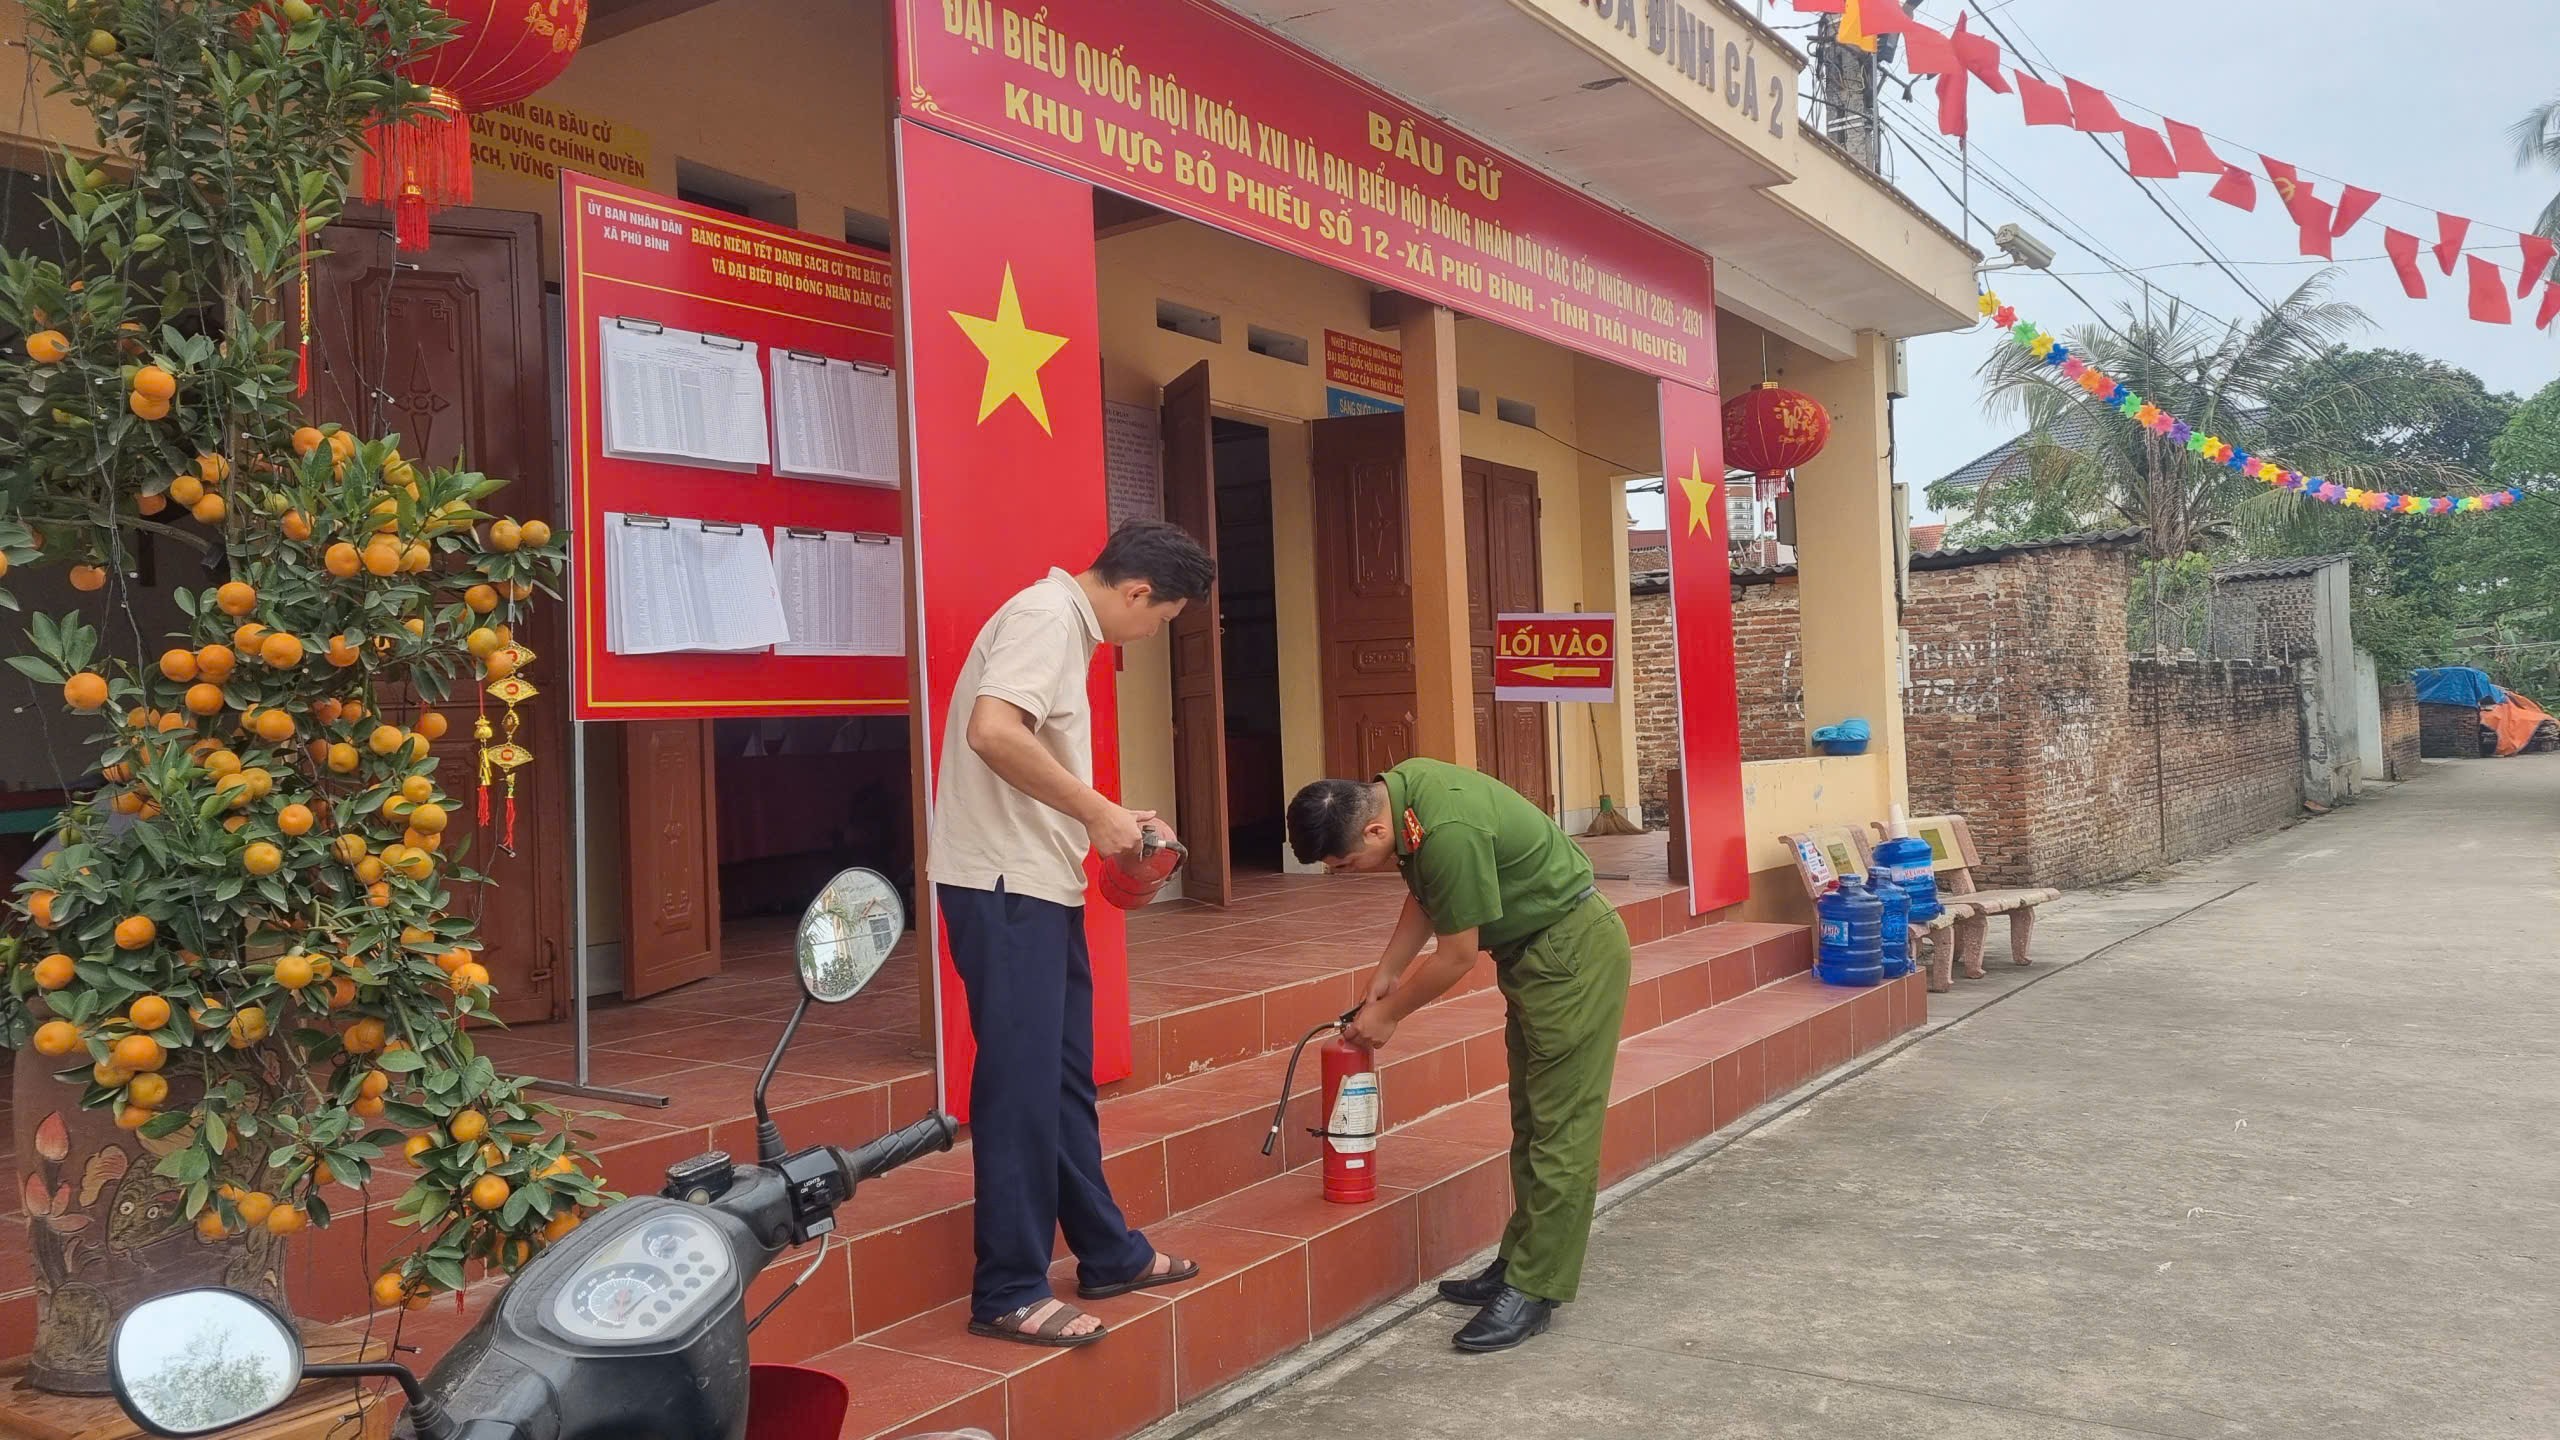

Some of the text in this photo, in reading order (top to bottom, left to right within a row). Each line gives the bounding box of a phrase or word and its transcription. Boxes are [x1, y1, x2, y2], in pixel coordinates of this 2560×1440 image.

[1724, 38, 1759, 122] CẢ
[1768, 75, 1783, 139] 2
[500, 123, 545, 151] DỰNG
[549, 138, 595, 165] CHÍNH
[598, 152, 645, 178] QUYỀN
[529, 106, 555, 128] GIA
[559, 110, 588, 137] BẦU
[592, 120, 612, 143] CỬ
[470, 142, 505, 170] ẠCH,
[509, 152, 554, 179] VỮNG
[942, 0, 994, 55] ĐẠI
[1003, 5, 1066, 79] BIỂU
[1075, 44, 1142, 110] QUỐC
[1149, 73, 1188, 136] HỘI
[1194, 100, 1252, 158] KHÓA
[1257, 121, 1289, 173] XVI
[1294, 136, 1319, 186] VÀ
[1323, 152, 1354, 205] ĐẠI
[1358, 161, 1396, 217] BIỂU
[1400, 183, 1427, 235] HỘI
[1431, 193, 1471, 247] ĐỒNG
[1475, 218, 1513, 264] NHÂN
[1516, 233, 1543, 276] DÂN
[1545, 247, 1569, 287] CÁC
[1572, 254, 1595, 295] CẤP
[1598, 271, 1633, 314] NHIỆM
[1635, 283, 1648, 318] KỲ
[1651, 294, 1674, 328] 2026
[1682, 307, 1703, 339] 2031
[1368, 110, 1502, 200] BẦU CỬ
[588, 199, 683, 235] ỦY BAN NHÂN DÂN
[603, 226, 670, 252] XÃ PHÚ BÌNH
[1004, 81, 1083, 143] KHU
[1095, 118, 1164, 174] VỰC
[1175, 150, 1217, 194] BỎ
[1227, 170, 1311, 230] PHIẾU
[1319, 208, 1353, 246] SỐ
[1361, 225, 1390, 260] 12
[1441, 255, 1482, 294] PHÚ
[1488, 272, 1534, 313] BÌNH
[1551, 293, 1589, 333] TỈNH
[1593, 313, 1628, 346] THÁI
[1632, 327, 1687, 367] NGUYÊN
[691, 226, 721, 247] BẢNG
[723, 234, 751, 256] NIÊM
[753, 239, 773, 260] YẾT
[774, 248, 803, 267] DANH
[804, 252, 829, 275] SÁCH
[845, 264, 861, 280] TRI
[711, 256, 891, 310] VÀ ĐẠI BIỂU HỘI ĐỒNG NHÂN DÂN CÁC
[1500, 624, 1608, 656] LỐI VÀO
